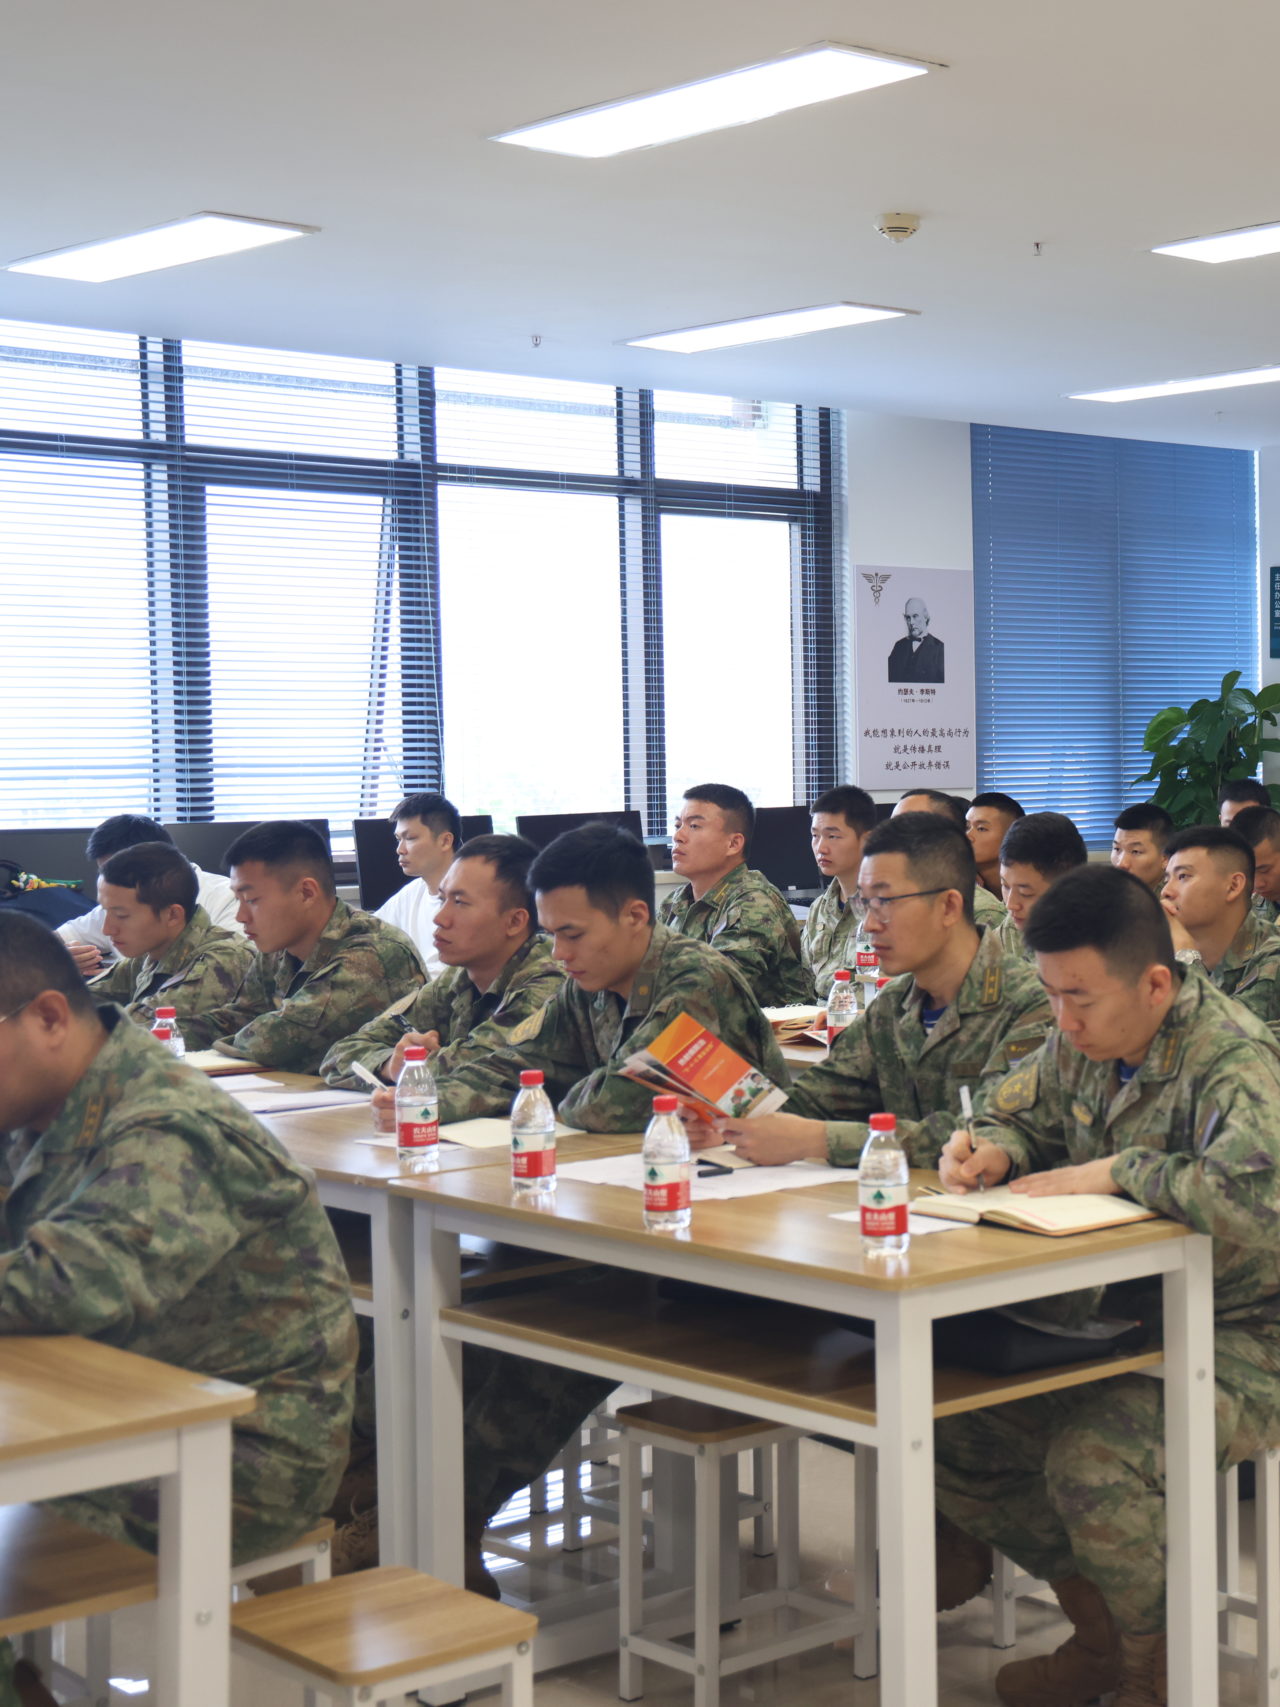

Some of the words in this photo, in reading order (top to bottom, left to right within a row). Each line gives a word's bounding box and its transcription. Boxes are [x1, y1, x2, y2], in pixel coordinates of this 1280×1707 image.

[893, 744, 942, 755] 就是传播真理
